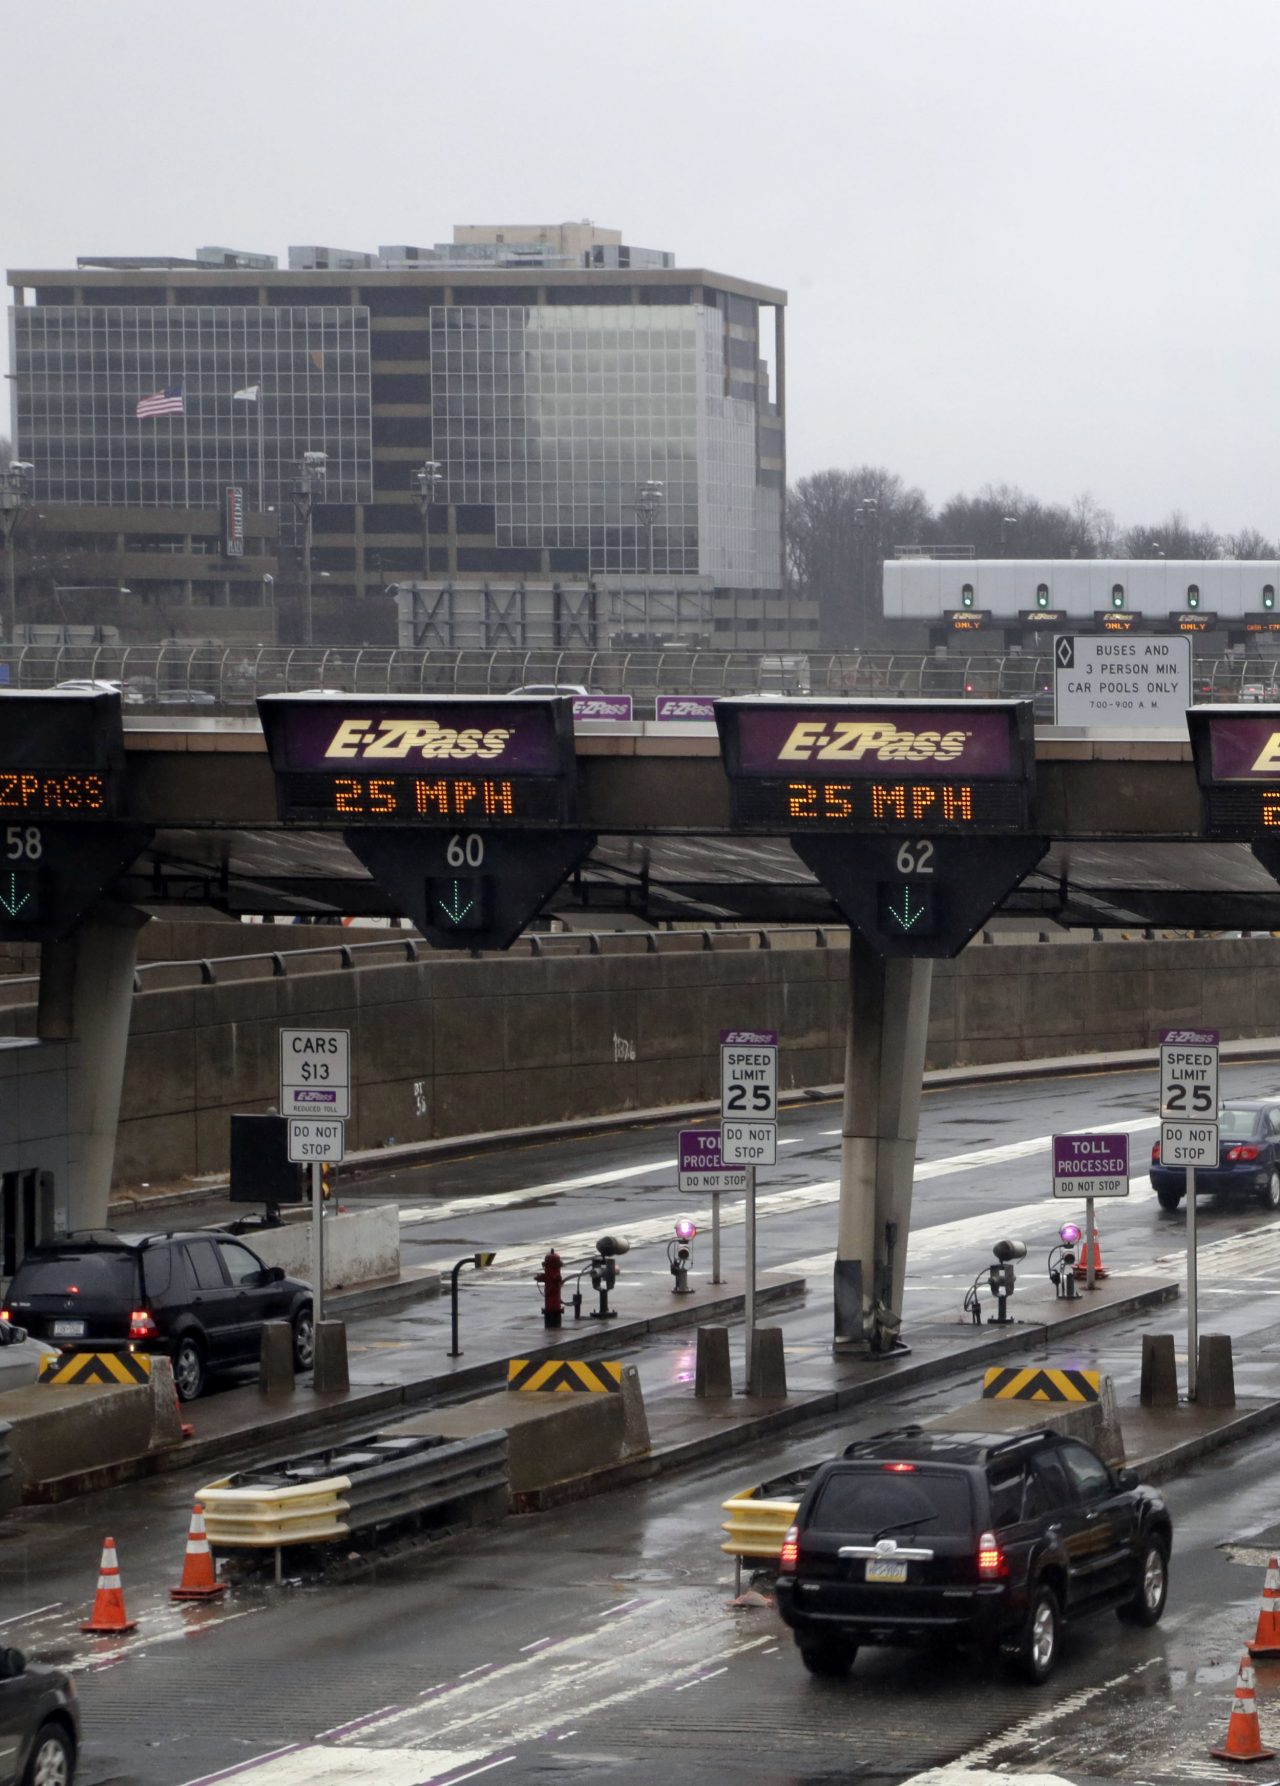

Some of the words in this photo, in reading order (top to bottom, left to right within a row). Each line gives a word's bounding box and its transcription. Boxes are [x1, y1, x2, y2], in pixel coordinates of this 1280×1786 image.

[1096, 645, 1136, 656] BUSES
[1144, 645, 1169, 656] AND
[1086, 664, 1093, 674] 3
[1101, 664, 1149, 674] PERSON
[1067, 682, 1091, 693] CAR
[1100, 682, 1139, 693] POOLS
[1147, 682, 1179, 693] ONLY
[325, 719, 512, 760] E-ZPass
[778, 722, 968, 762] E-ZPass
[335, 779, 397, 813] 25
[416, 780, 514, 815] MPH
[789, 784, 852, 819] 25
[872, 785, 972, 820] MPH
[6, 826, 43, 860] 58
[446, 834, 484, 868] 60
[896, 840, 934, 874] 62
[292, 1037, 338, 1054] CARS
[728, 1054, 771, 1066] SPEED
[1167, 1053, 1213, 1066] SPEED
[301, 1061, 330, 1081] $13
[732, 1069, 766, 1081] LIMIT
[1171, 1069, 1207, 1081] LIMIT
[727, 1084, 771, 1112] 25
[1166, 1084, 1213, 1112] 25
[293, 1105, 321, 1113] REDUCED
[294, 1126, 309, 1137] DO
[316, 1126, 338, 1138] NOT
[727, 1129, 742, 1140] DO
[749, 1129, 772, 1141] NOT
[1166, 1129, 1182, 1141] DO
[1189, 1130, 1213, 1142] NOT
[302, 1143, 331, 1155] STOP
[735, 1147, 764, 1158] STOP
[1071, 1141, 1111, 1154] TOLL
[1174, 1147, 1205, 1159] STOP
[1058, 1159, 1124, 1173] PROCESSED
[686, 1176, 699, 1187] DO
[703, 1175, 721, 1186] NOT
[724, 1175, 747, 1185] STOP
[1061, 1182, 1074, 1192] DO
[1078, 1181, 1095, 1192] NOT
[1099, 1180, 1121, 1191] STOP
